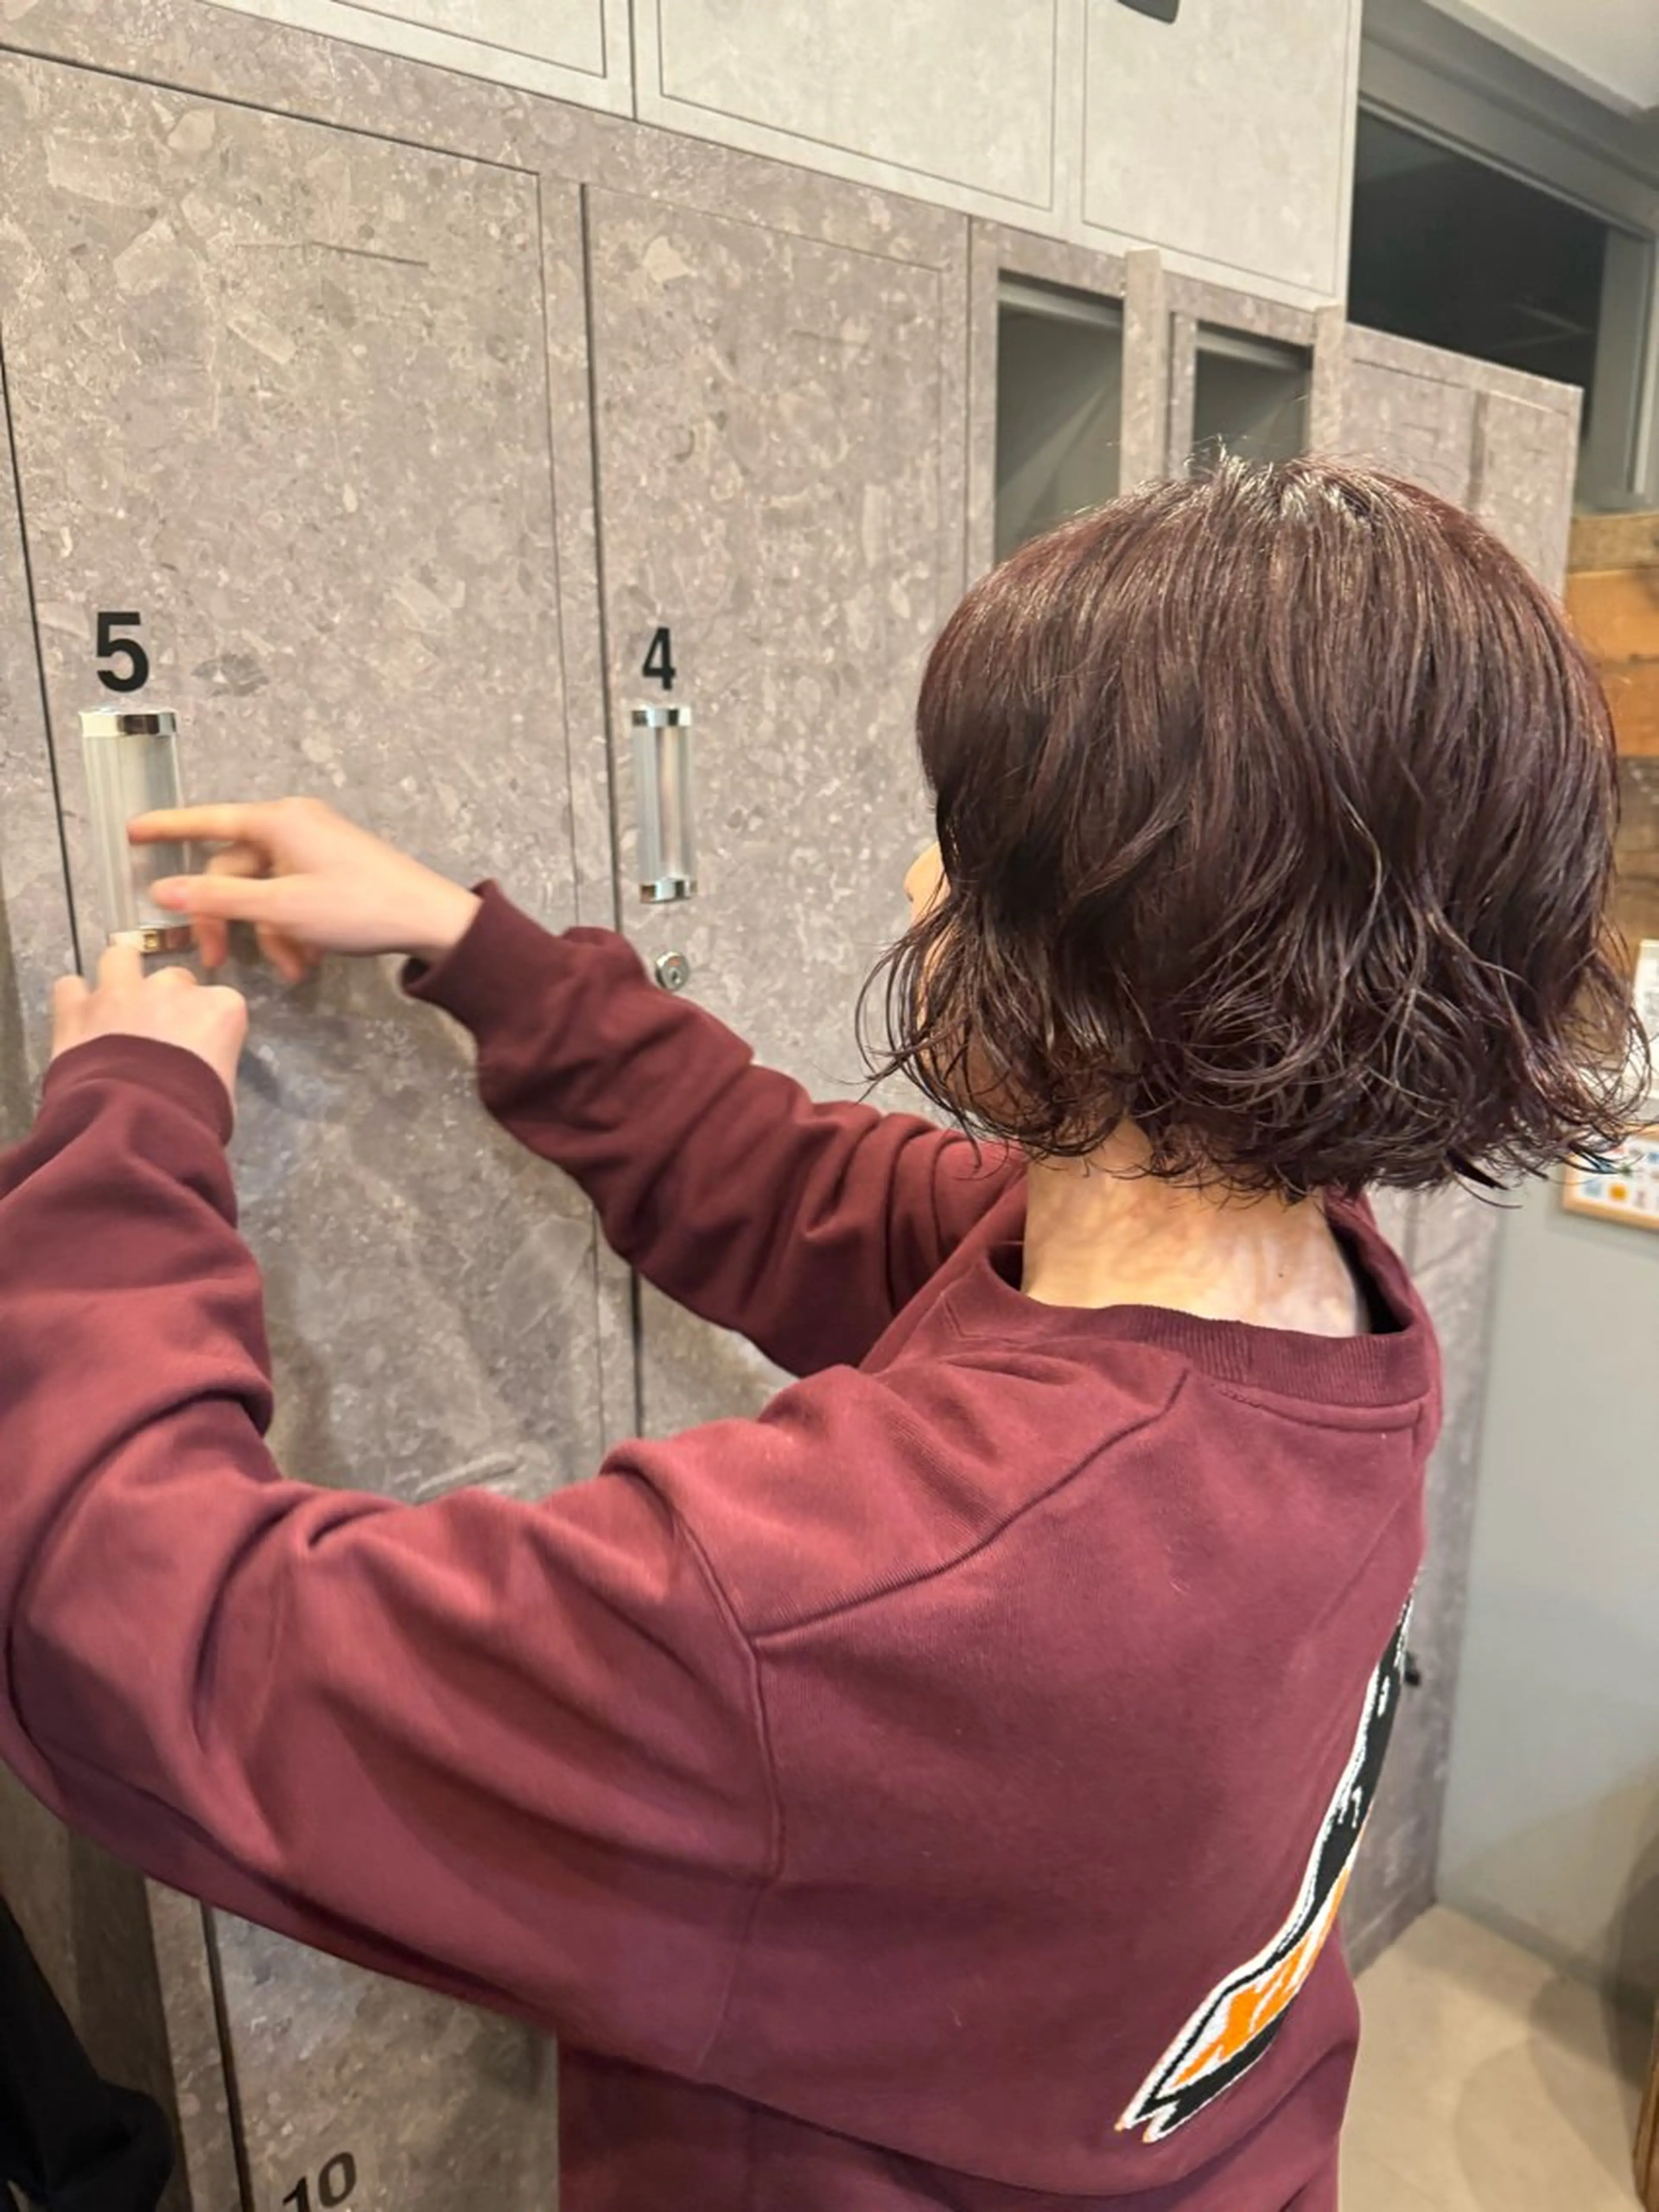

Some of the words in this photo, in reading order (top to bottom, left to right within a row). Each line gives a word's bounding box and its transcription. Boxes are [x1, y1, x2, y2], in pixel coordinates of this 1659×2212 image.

[96, 611, 149, 693] 5
[642, 627, 676, 690] 4
[282, 2152, 356, 2212] 10
